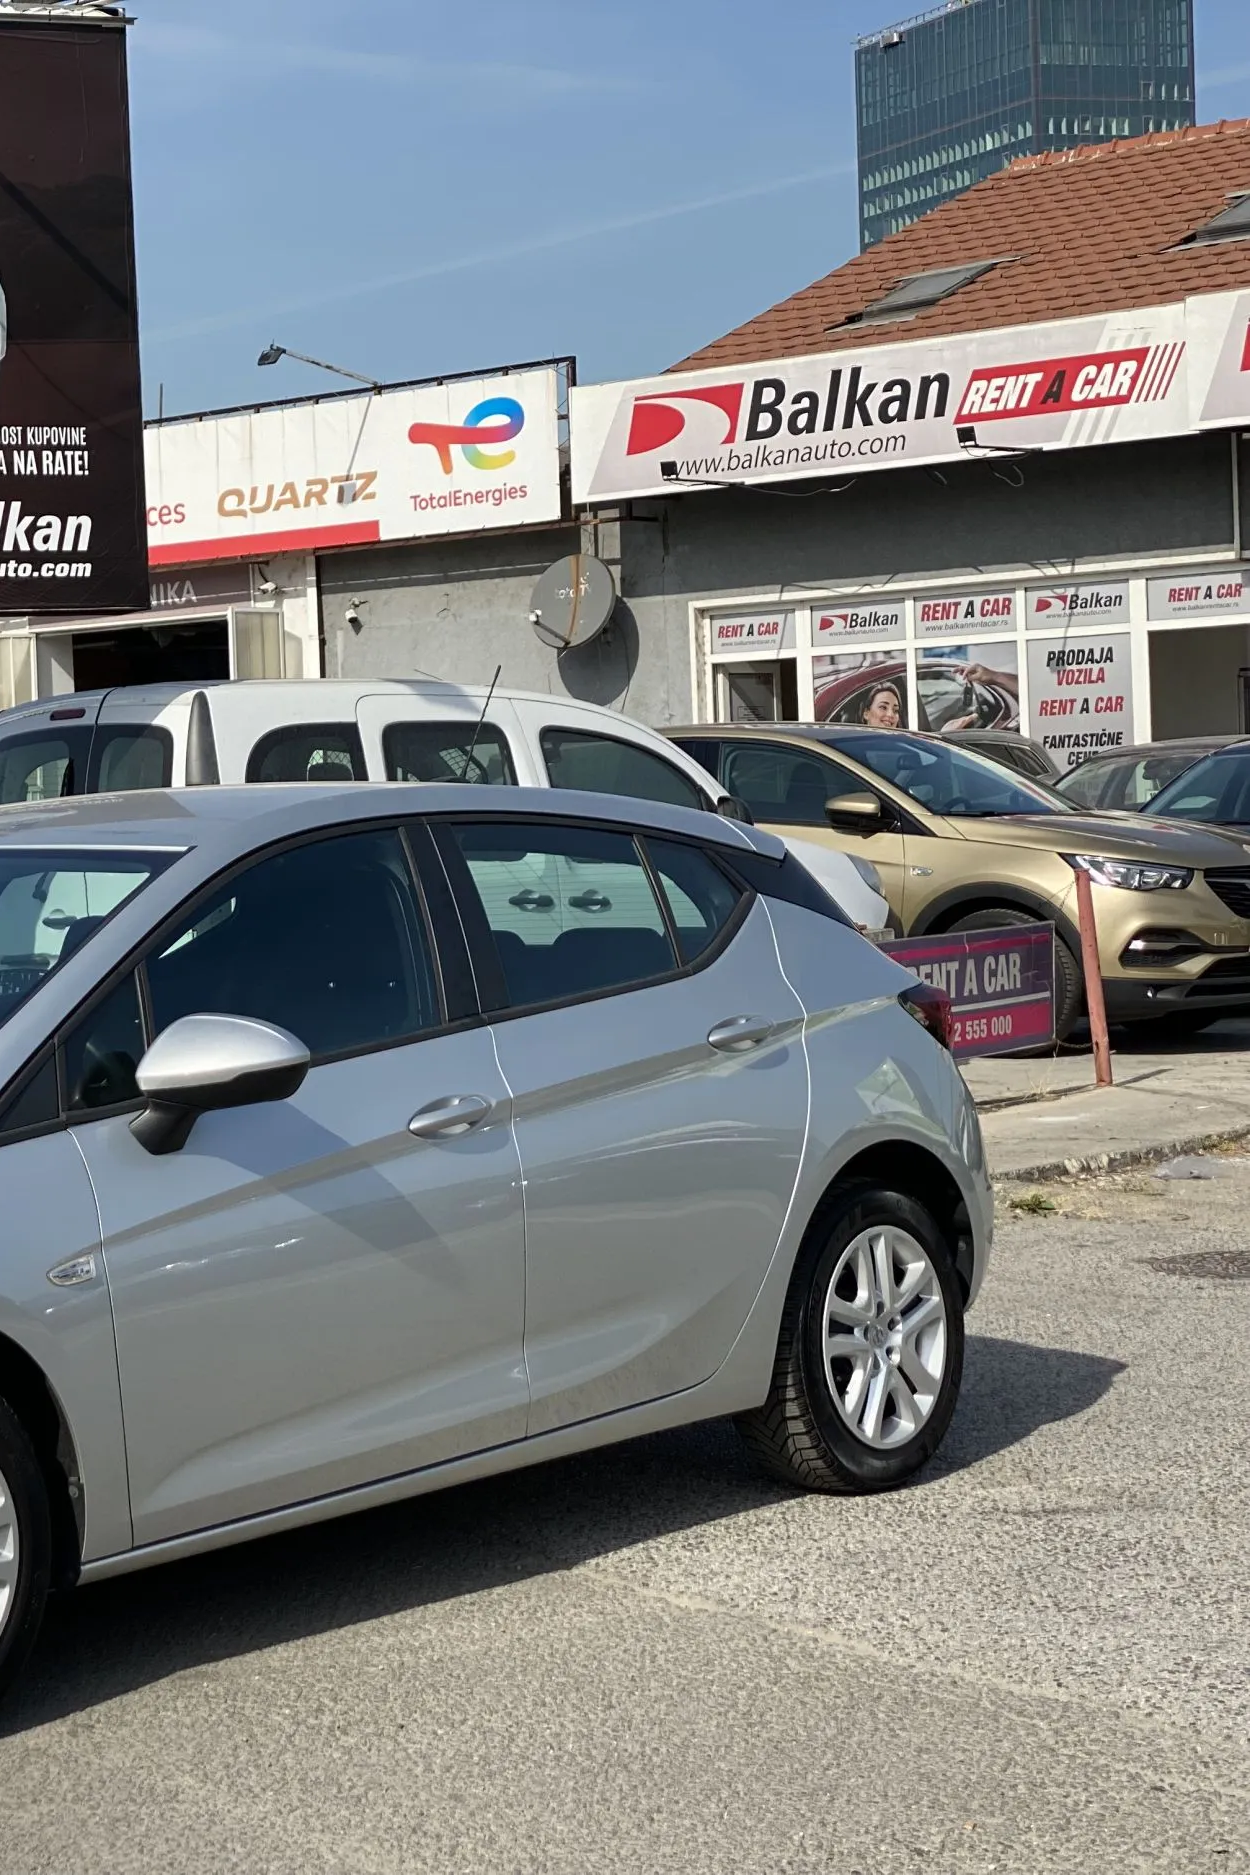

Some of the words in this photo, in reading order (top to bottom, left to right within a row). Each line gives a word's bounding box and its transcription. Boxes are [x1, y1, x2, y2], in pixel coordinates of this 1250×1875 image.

[745, 366, 950, 442] Balkan
[960, 371, 1044, 416] RENT
[1041, 369, 1067, 405] A
[1070, 360, 1139, 402] CAR
[26, 426, 87, 446] KUPOVINE
[13, 450, 38, 475] NA
[42, 450, 90, 476] RATE!
[217, 471, 378, 518] QUARTZ
[409, 483, 528, 511] TotalEnergies
[1068, 592, 1123, 611] Balkan
[1168, 586, 1201, 602] RENT
[1203, 585, 1213, 600] A
[1216, 583, 1243, 599] CAR
[849, 611, 899, 629] Balkan
[920, 601, 962, 622] RENT
[963, 600, 975, 619] A
[980, 597, 1013, 618] CAR
[718, 624, 745, 639] RENT
[746, 623, 754, 637] A
[757, 621, 779, 636] CAR
[1046, 646, 1114, 667] PRODAJA
[1056, 667, 1105, 686] VOZILA
[1039, 698, 1077, 716] RENT
[1079, 697, 1090, 714] A
[1094, 695, 1124, 713] CAR
[1043, 727, 1123, 750] FANTASTIČNE
[963, 958, 978, 997] A
[983, 952, 1021, 993] CAR
[965, 1017, 988, 1040] 555
[991, 1014, 1013, 1036] 000
